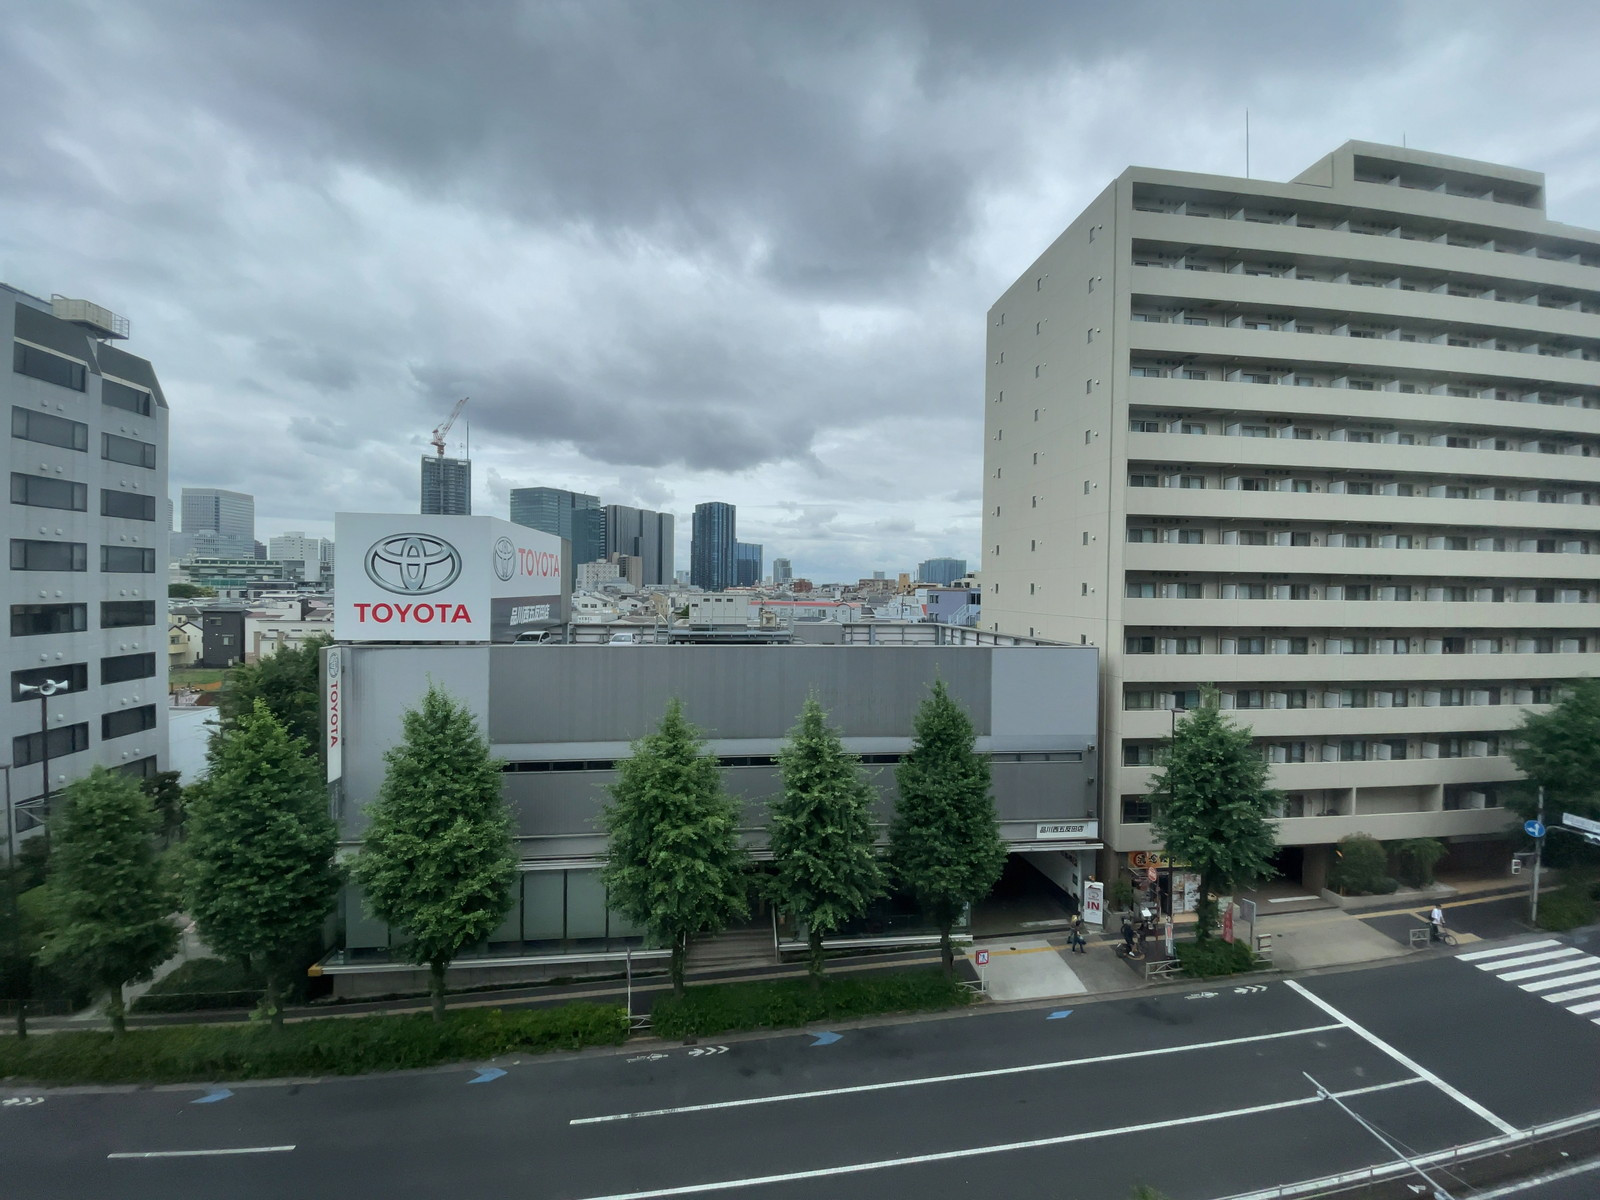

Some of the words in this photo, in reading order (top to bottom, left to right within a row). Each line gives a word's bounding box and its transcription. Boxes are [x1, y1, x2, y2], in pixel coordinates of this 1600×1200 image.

[518, 548, 560, 577] TOYOTA
[353, 603, 472, 624] TOYOTA
[330, 680, 339, 748] TOYOTA
[1087, 901, 1100, 911] IN
